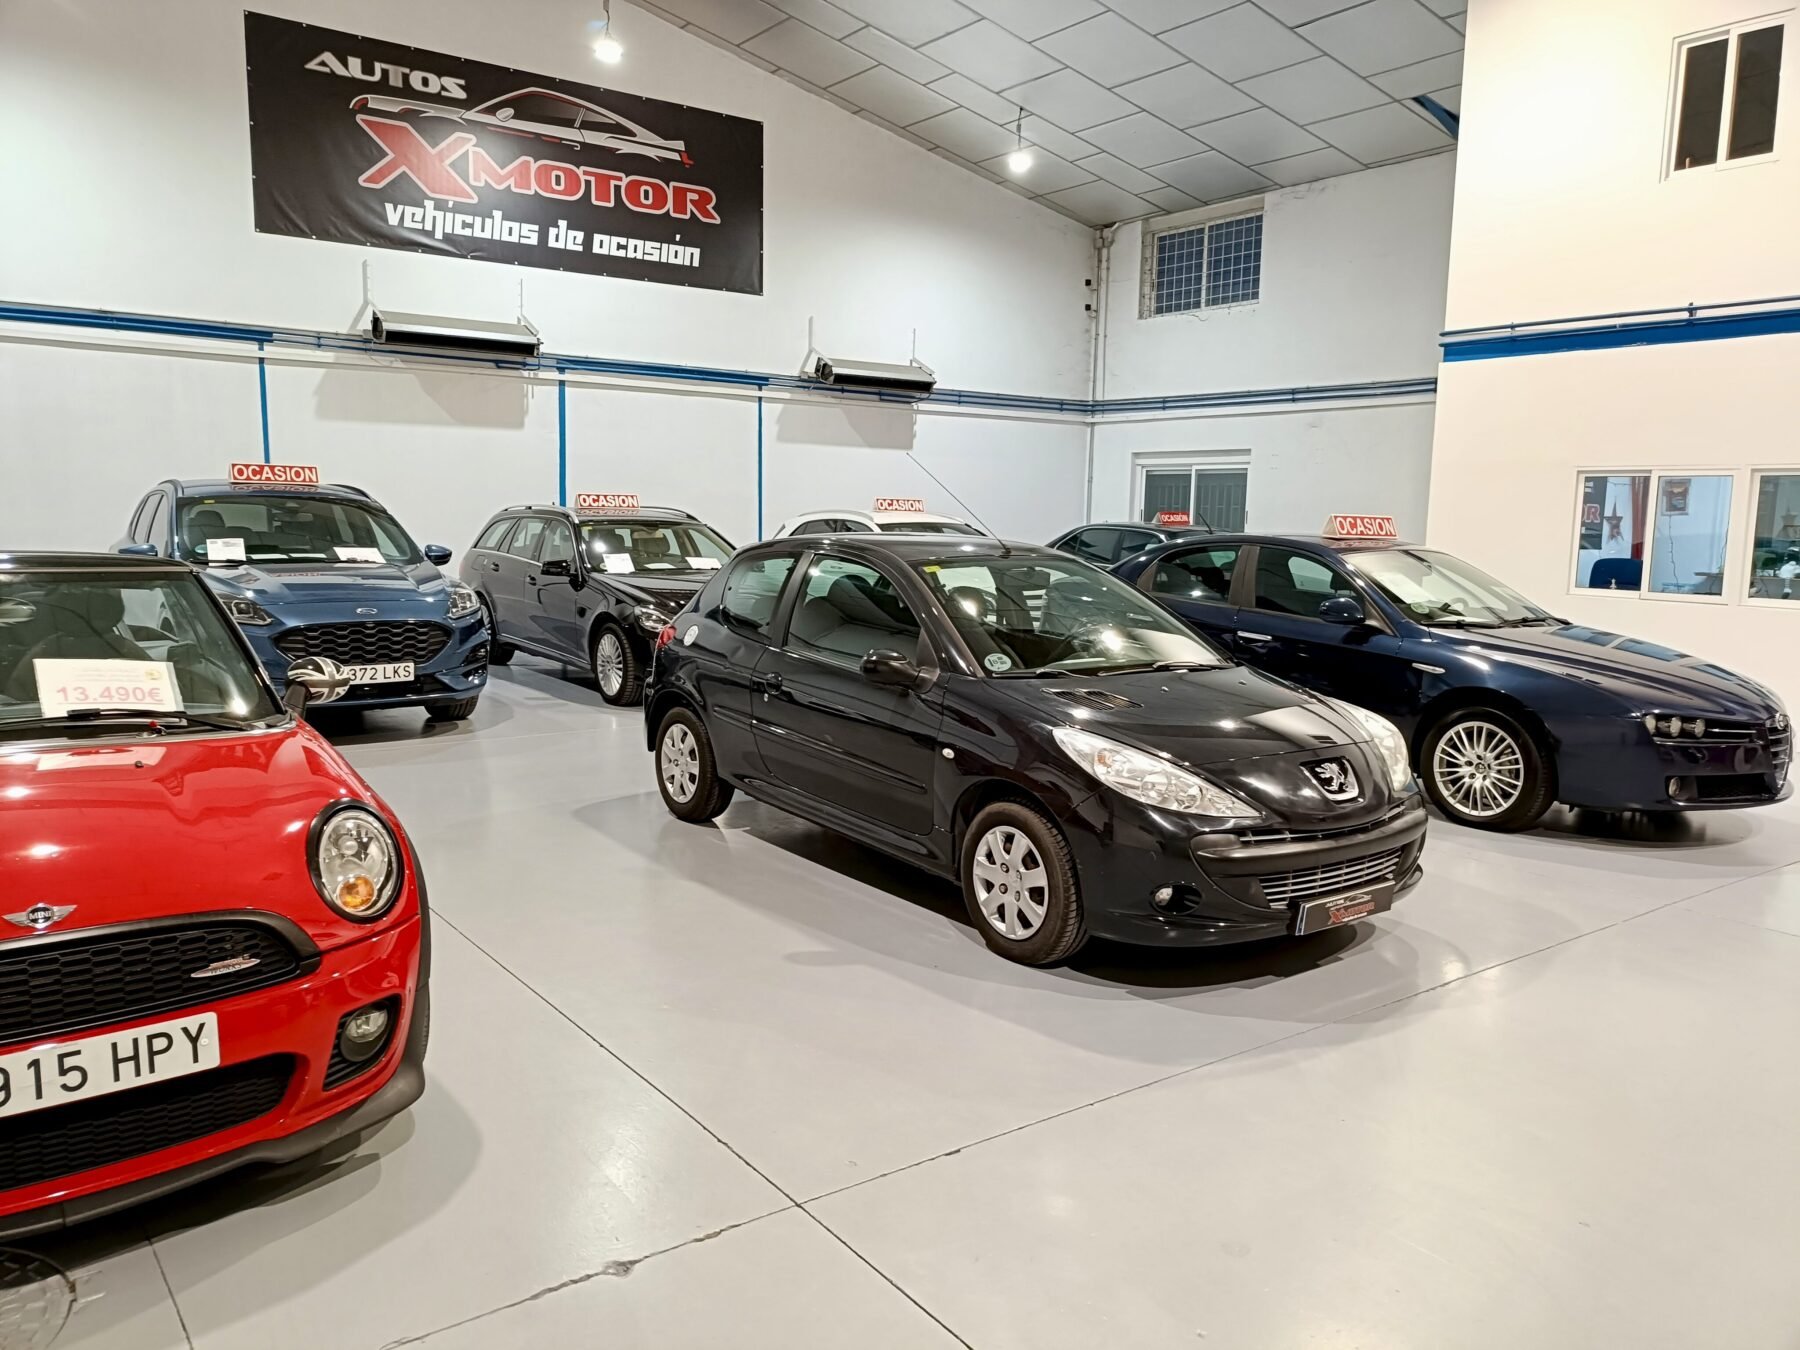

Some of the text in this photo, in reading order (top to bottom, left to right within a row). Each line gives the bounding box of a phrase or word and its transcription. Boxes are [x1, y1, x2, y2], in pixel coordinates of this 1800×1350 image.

[304, 51, 467, 99] AUTOS
[384, 199, 701, 267] vehículos de ocasión
[233, 465, 317, 482] OCASION
[580, 495, 638, 507] OCASION
[877, 499, 924, 511] OCASION
[1336, 517, 1396, 535] OCASION
[383, 665, 411, 680] LKS
[56, 685, 164, 702] 13.490€
[28, 910, 52, 920] MINI
[111, 1022, 206, 1083] HPY
